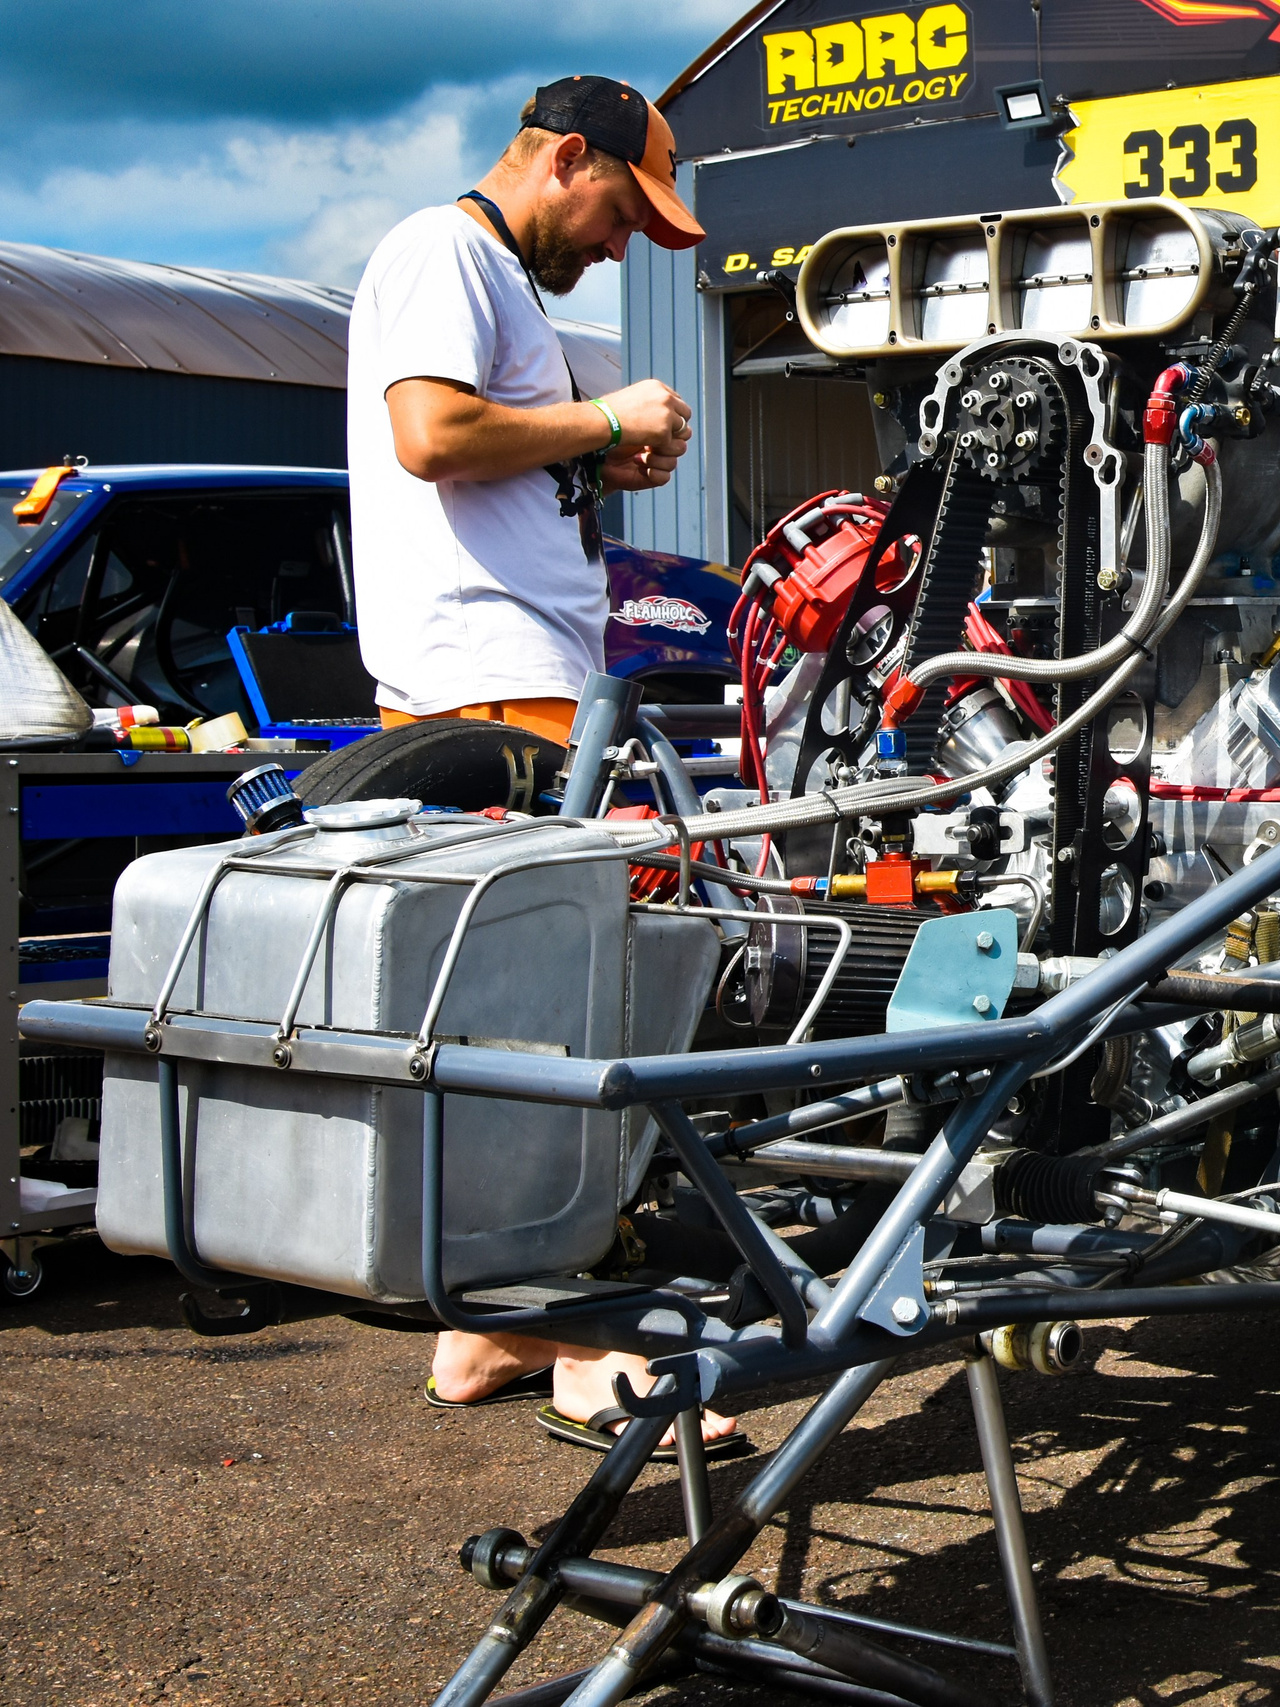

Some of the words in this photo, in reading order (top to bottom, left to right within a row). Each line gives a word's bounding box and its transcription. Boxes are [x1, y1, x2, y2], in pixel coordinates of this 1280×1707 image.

[763, 3, 967, 95] RDRC
[767, 72, 968, 124] TECHNOLOGY
[1123, 117, 1258, 199] 333
[724, 253, 757, 273] D.
